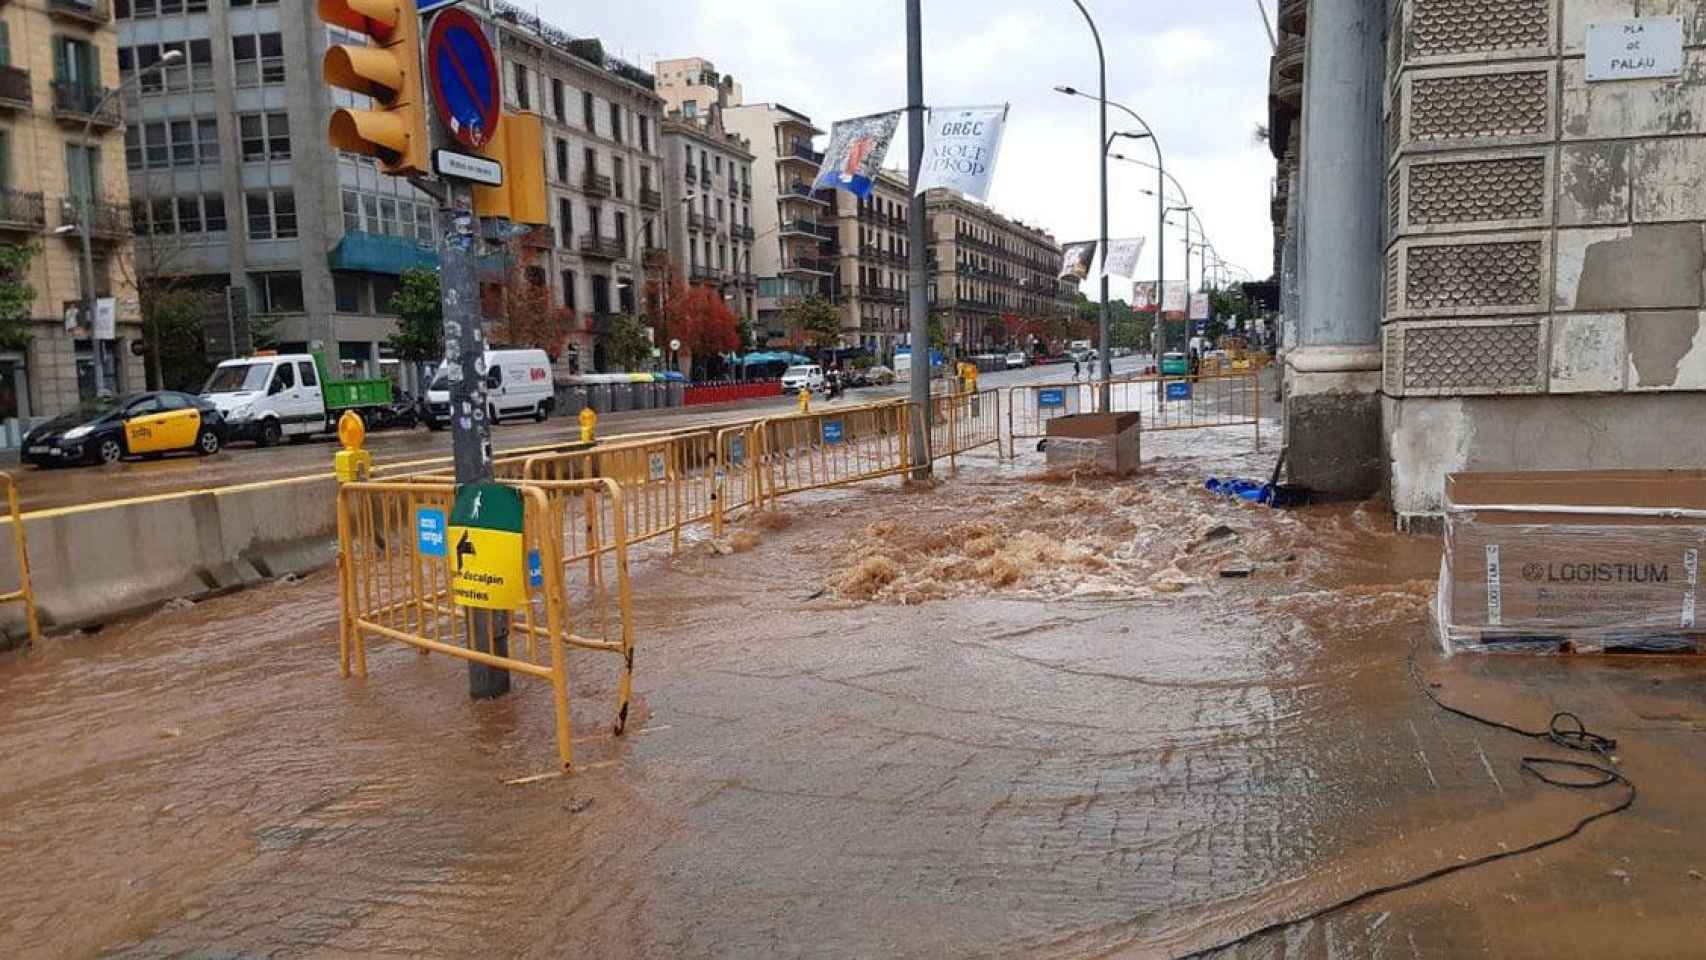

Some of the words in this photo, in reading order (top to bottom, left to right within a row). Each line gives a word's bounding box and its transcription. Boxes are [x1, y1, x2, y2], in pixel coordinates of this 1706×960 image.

[1624, 25, 1644, 34] PLA
[1611, 58, 1655, 70] PALAU
[1548, 563, 1669, 583] LOGISTIUM
